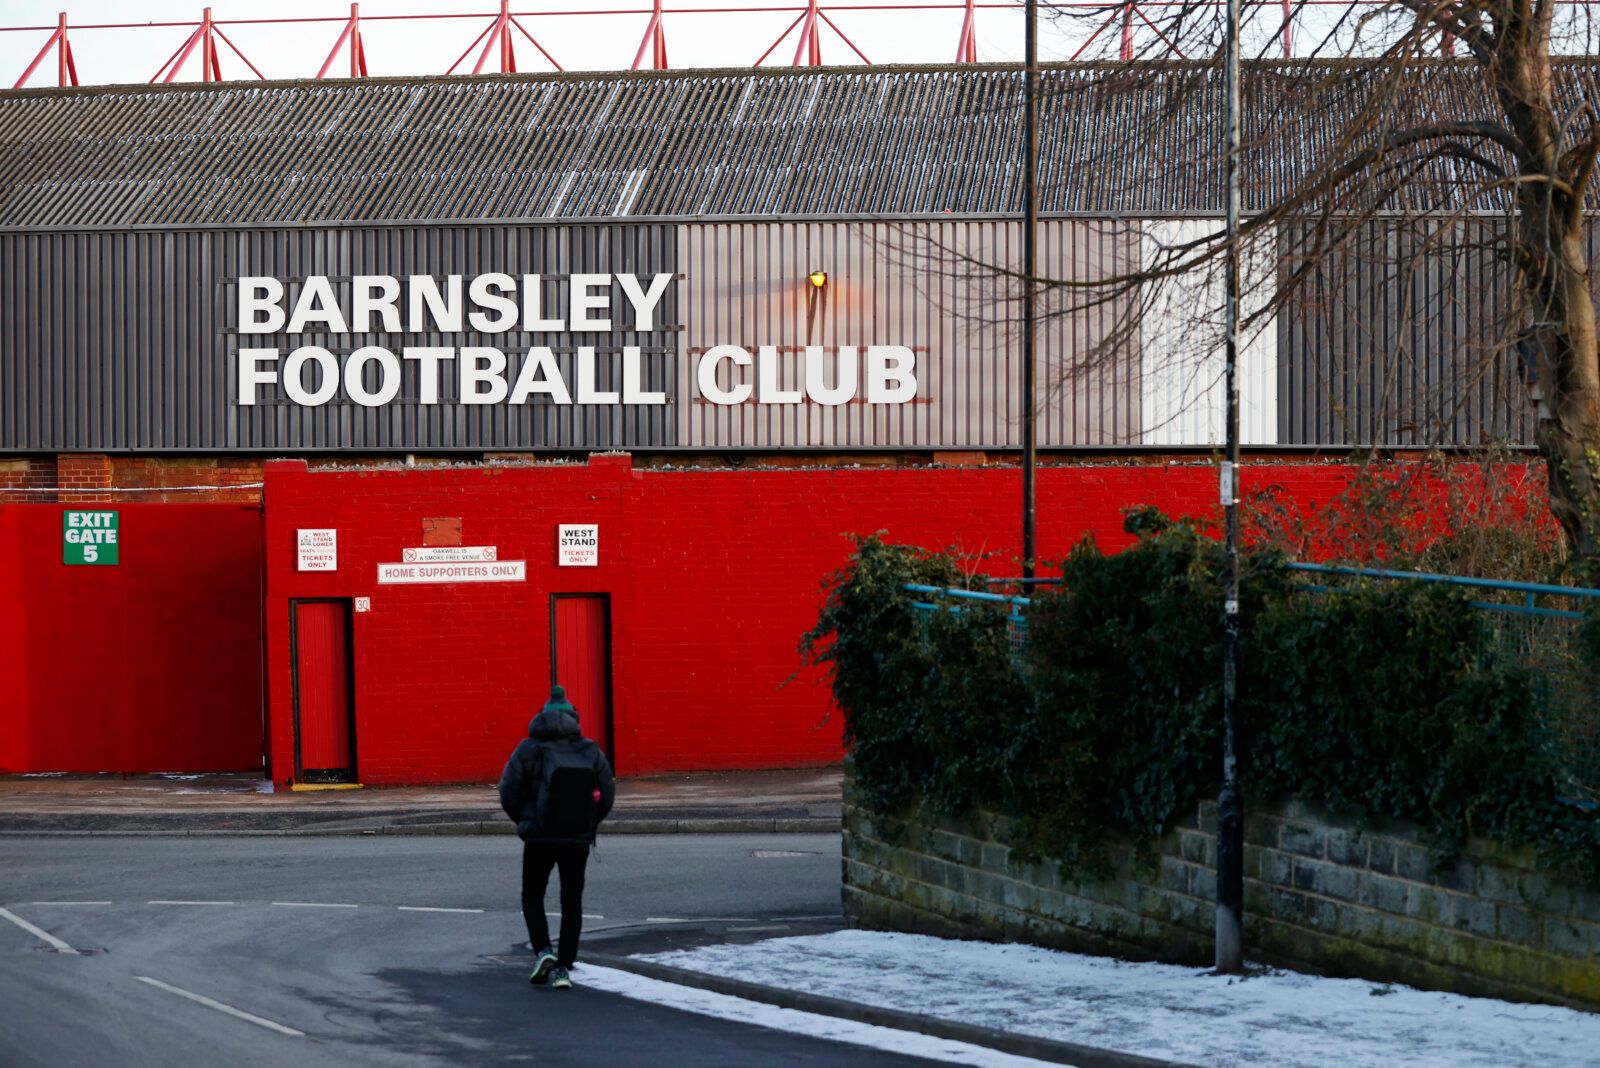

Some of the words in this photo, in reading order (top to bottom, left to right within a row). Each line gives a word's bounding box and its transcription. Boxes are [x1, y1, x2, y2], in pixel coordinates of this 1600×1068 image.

[238, 272, 674, 334] BARNSLEY
[238, 345, 666, 407] FOOTBALL
[698, 344, 918, 406] CLUB
[68, 512, 113, 527] EXIT
[65, 528, 116, 544] GATE
[83, 545, 98, 562] 5
[385, 568, 415, 578] HOME
[419, 567, 488, 577] SUPPORTERS
[492, 566, 518, 576] ONLY
[357, 599, 368, 609] 30
